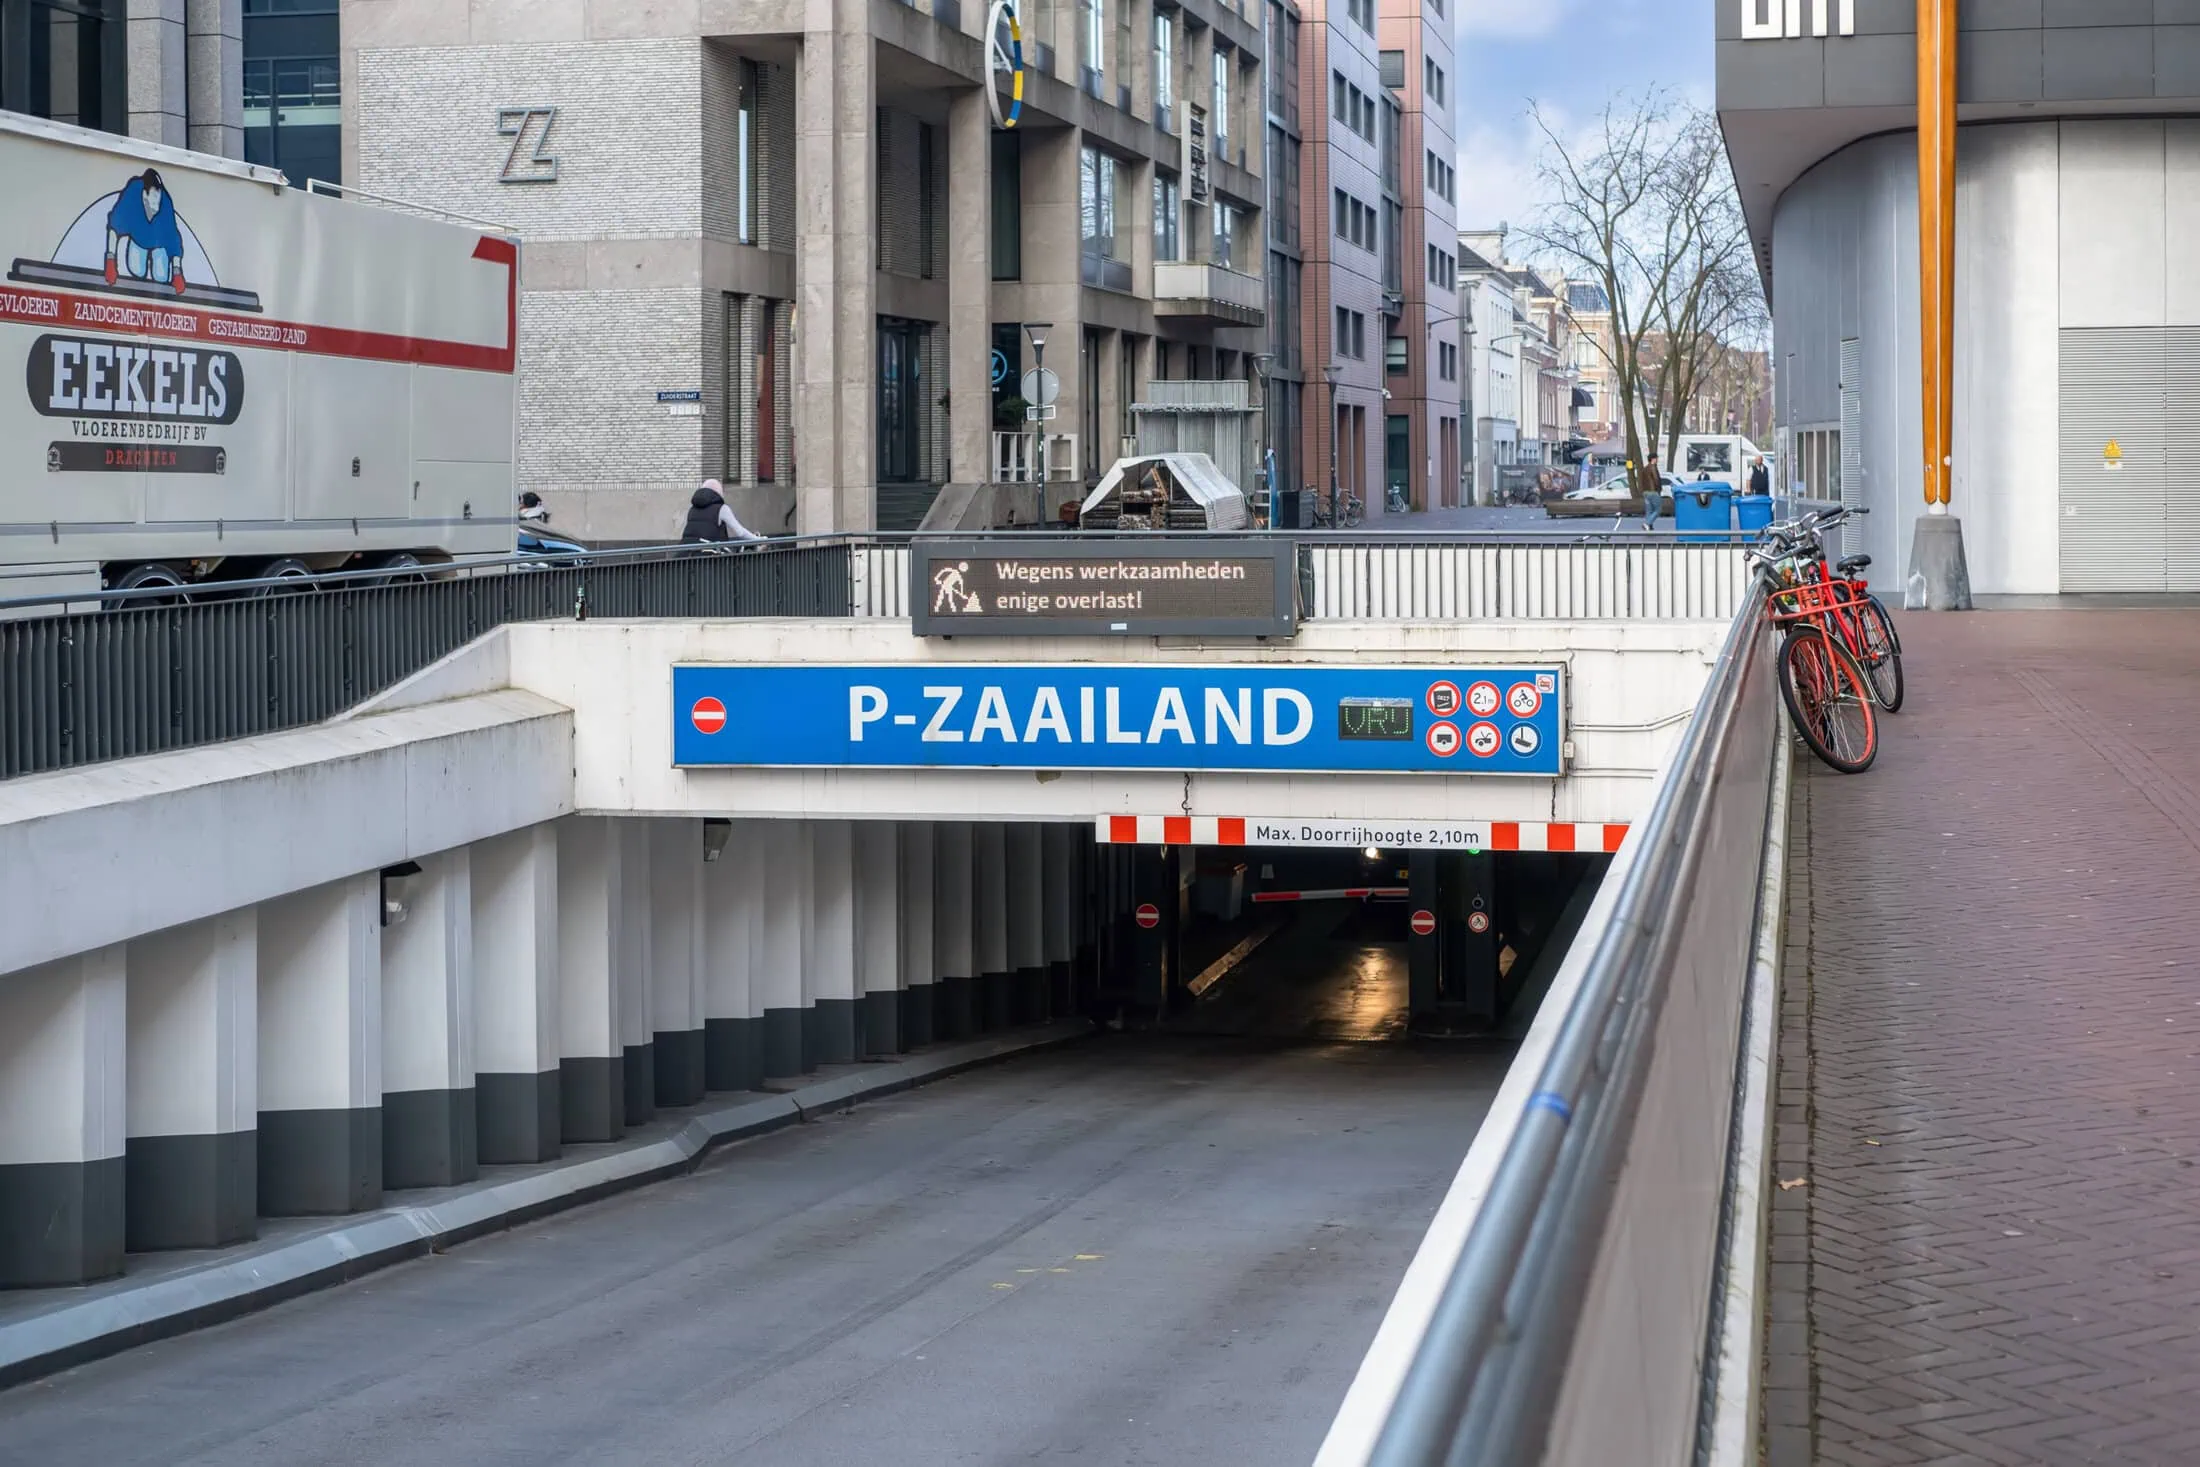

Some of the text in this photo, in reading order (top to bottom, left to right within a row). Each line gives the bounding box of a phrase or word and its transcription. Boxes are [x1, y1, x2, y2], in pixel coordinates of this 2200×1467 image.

[74, 302, 198, 332] ZANDCEMENTVLOEREN
[208, 318, 307, 345] GESTABILISEERD ZAND
[49, 339, 227, 418] EEKELS
[72, 420, 207, 443] VLOERENBEDRIJF BV
[105, 449, 177, 467] DRACHTEN
[996, 561, 1246, 583] Wegens werkzaamheden
[996, 591, 1143, 612] enige overlast!
[848, 685, 1315, 746] P-ZAAILAND
[1256, 826, 1480, 846] Max. Doorrijhoogte 2,10m
